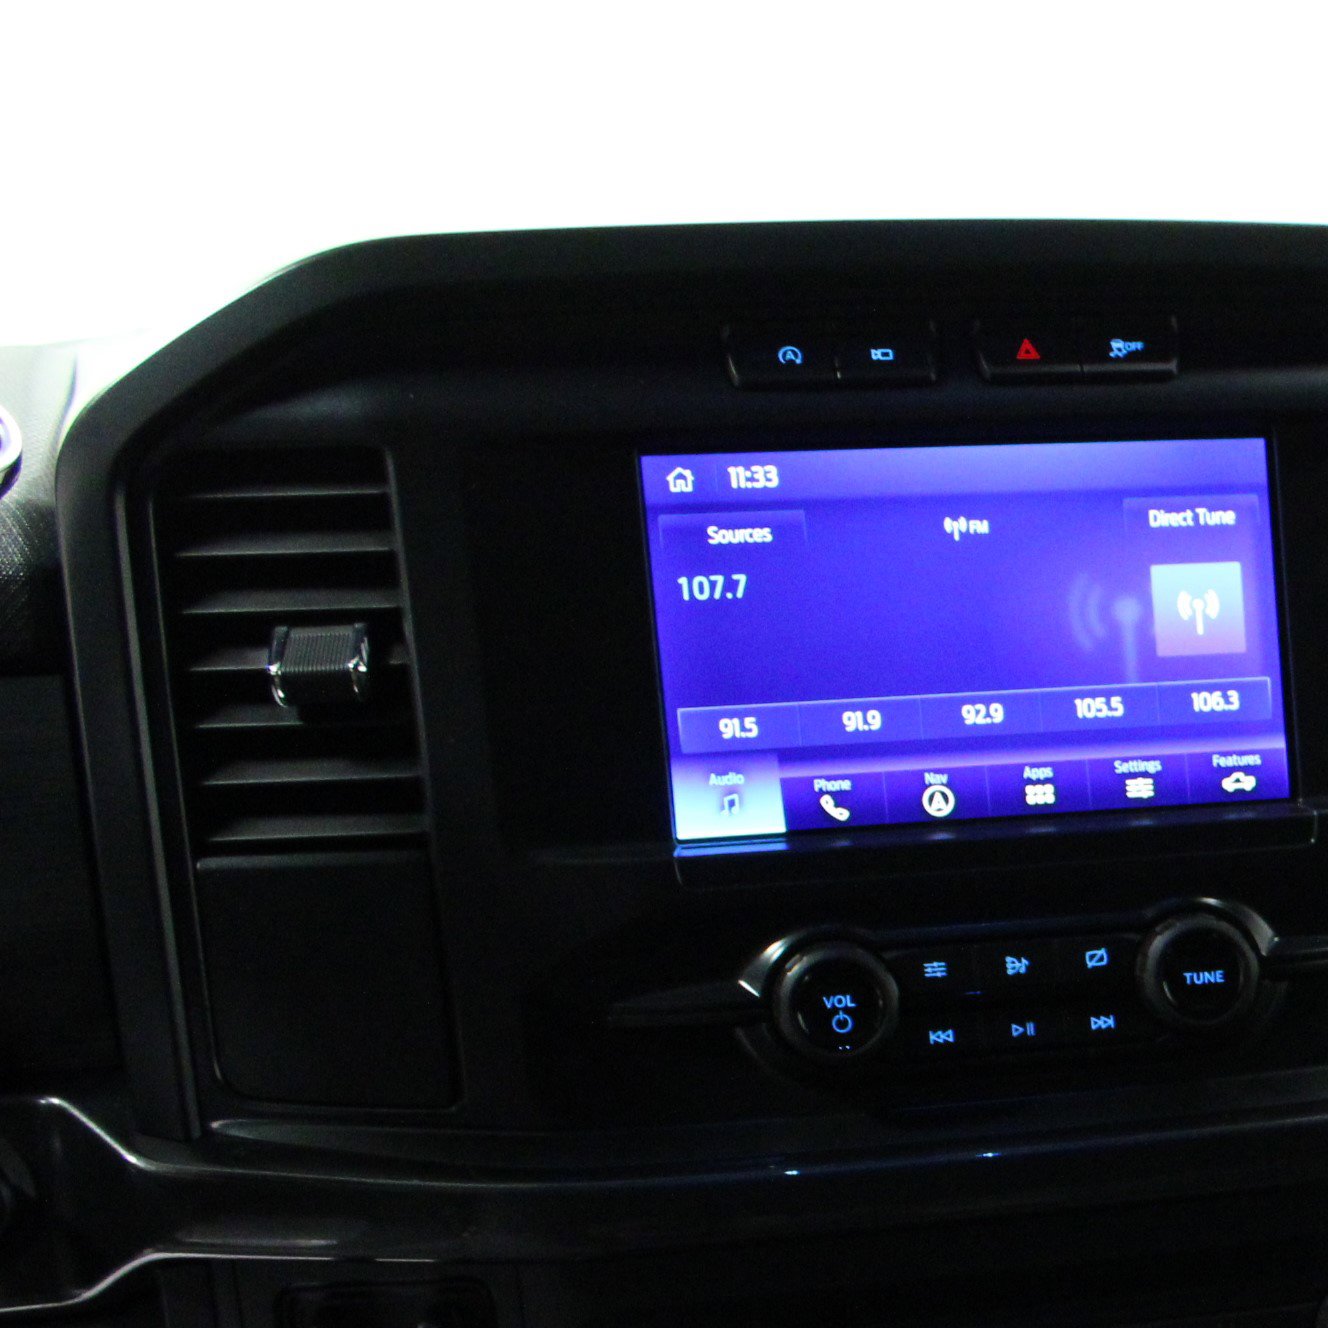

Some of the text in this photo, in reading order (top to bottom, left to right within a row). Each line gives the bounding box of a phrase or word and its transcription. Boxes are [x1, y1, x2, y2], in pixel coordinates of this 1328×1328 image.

[727, 465, 779, 489] 11:33
[968, 519, 989, 534] FM
[1148, 508, 1236, 528] Direct Tune
[707, 525, 773, 545] Sources
[677, 574, 747, 601] 107.7
[1074, 696, 1124, 719] 105.5
[1191, 690, 1240, 712] 106.3
[842, 710, 882, 732] 91.9
[961, 703, 1004, 725] 92.9
[719, 717, 758, 739] 91.5
[1114, 759, 1162, 775] Settings
[1212, 754, 1261, 768] Features
[708, 772, 744, 786] Audio
[924, 772, 948, 785] Nav
[1023, 766, 1053, 781] Apps
[813, 778, 852, 792] Phone
[1183, 969, 1226, 986] TUNE
[822, 995, 857, 1010] VOL
